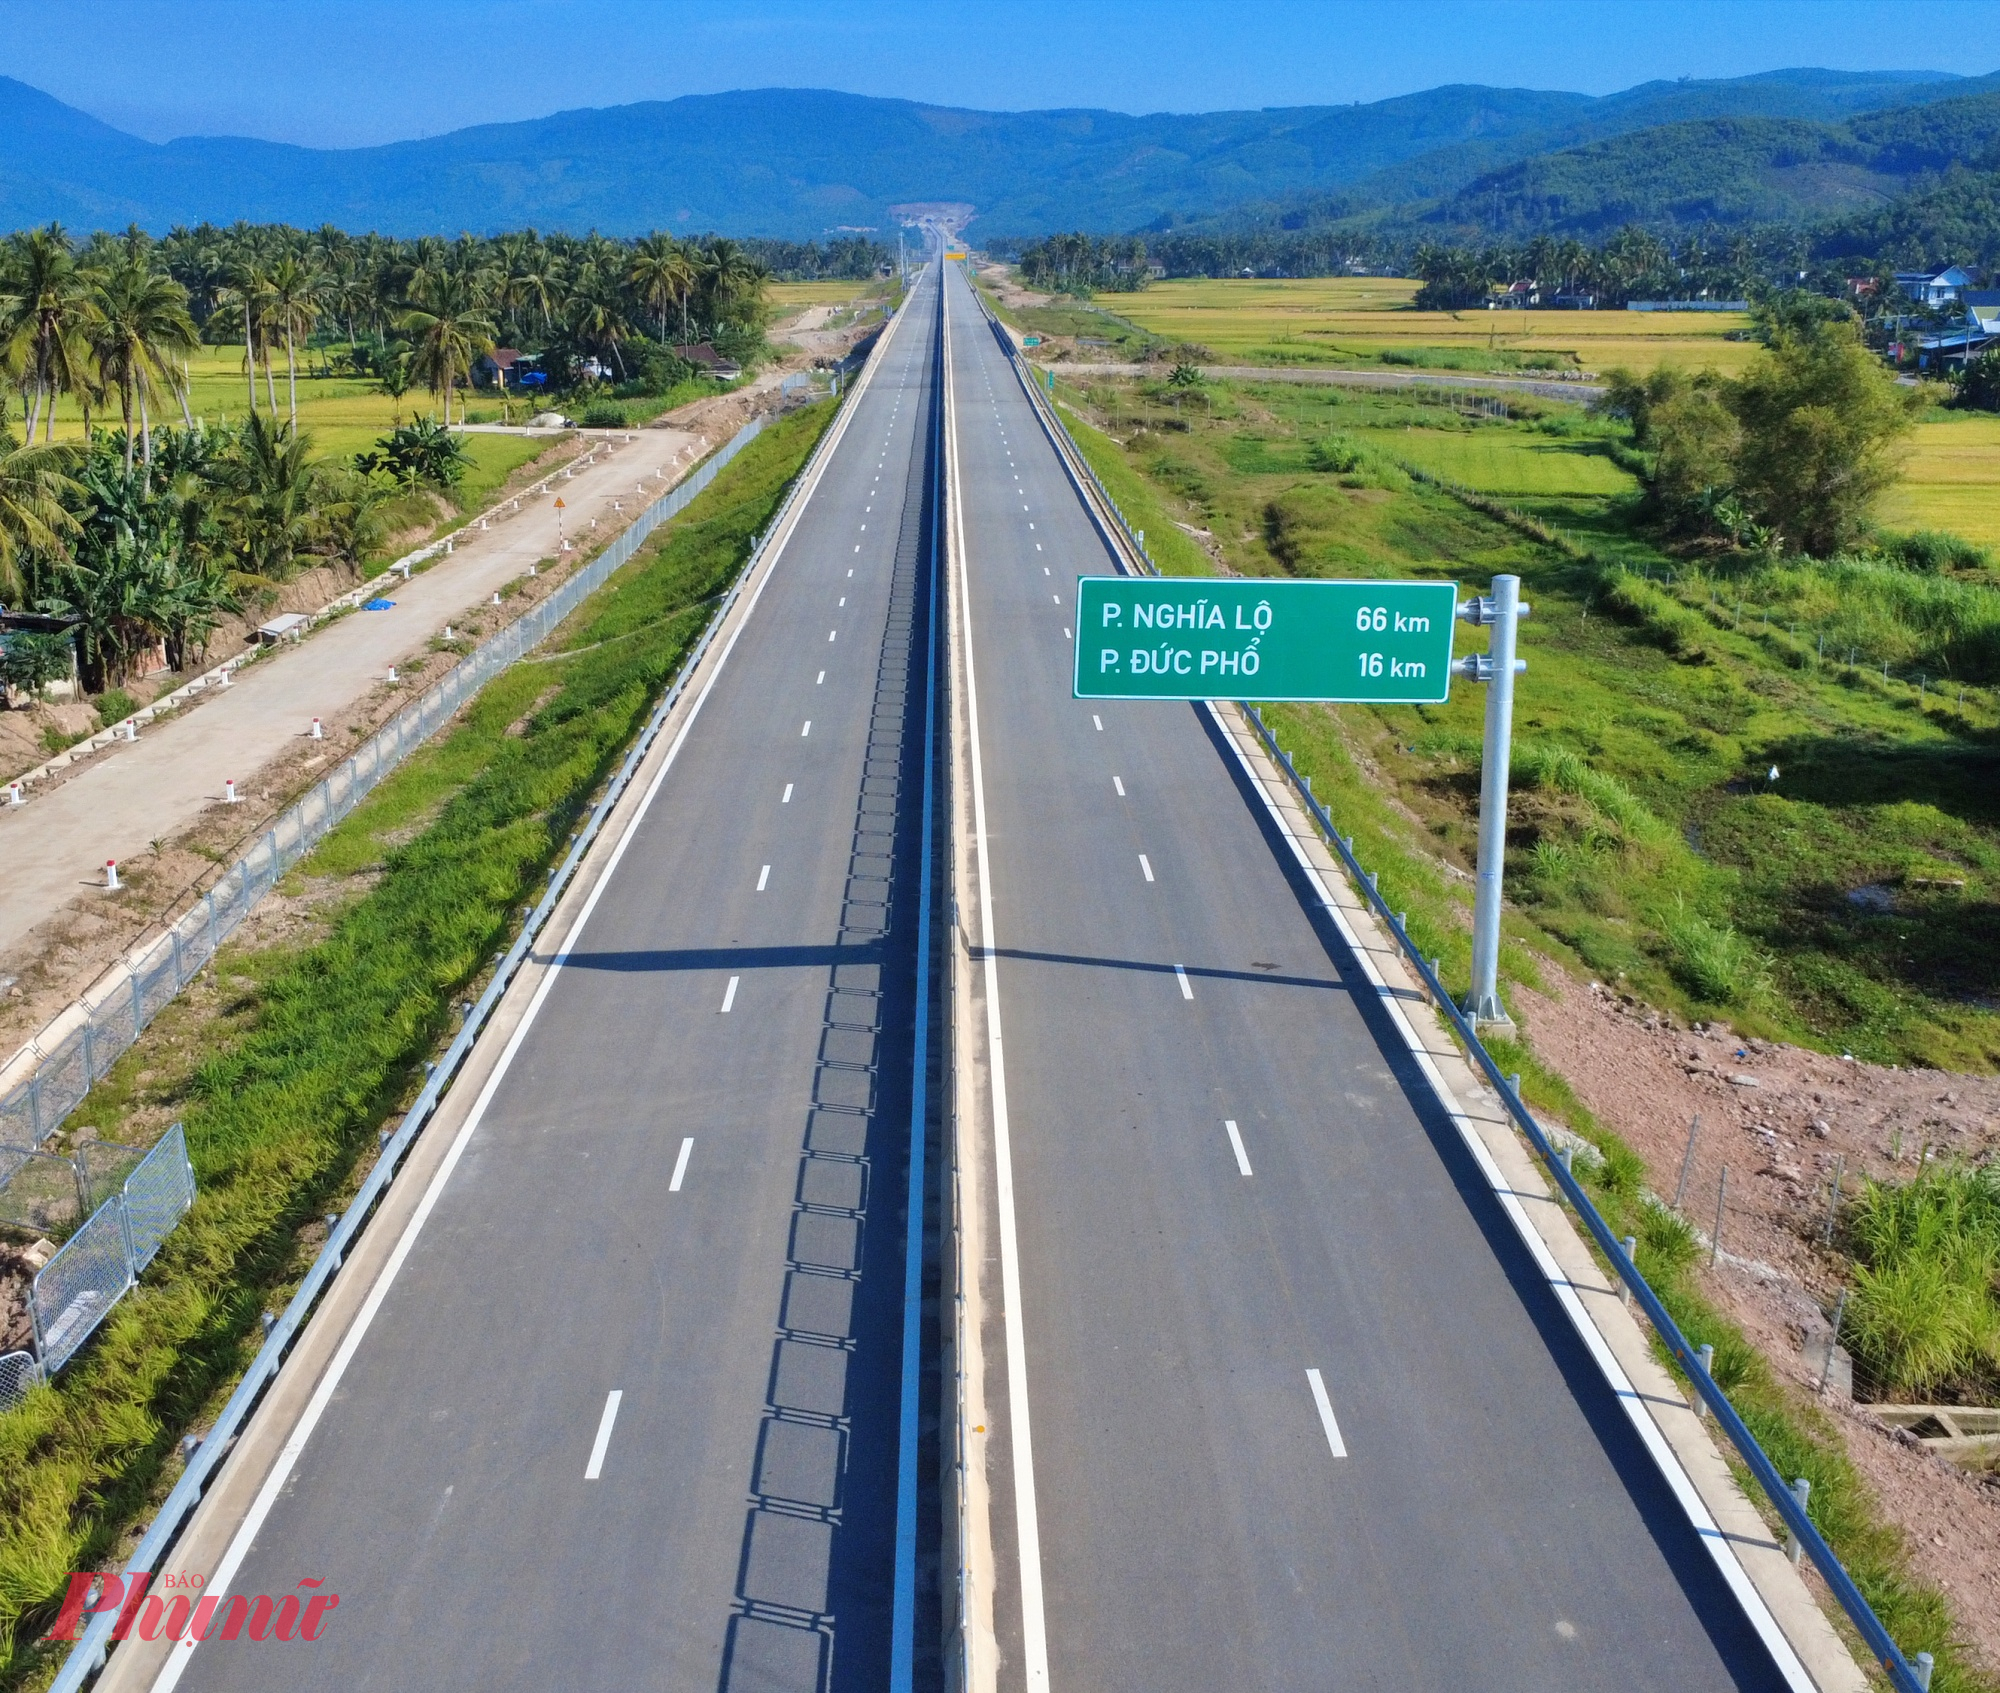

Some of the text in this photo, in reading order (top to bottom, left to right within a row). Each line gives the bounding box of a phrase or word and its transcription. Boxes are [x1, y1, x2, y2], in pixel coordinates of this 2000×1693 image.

[1101, 599, 1430, 636] P. NGHĨA LỘ 66 km
[1100, 637, 1426, 678] P. ĐỨC PHỔ 16 km
